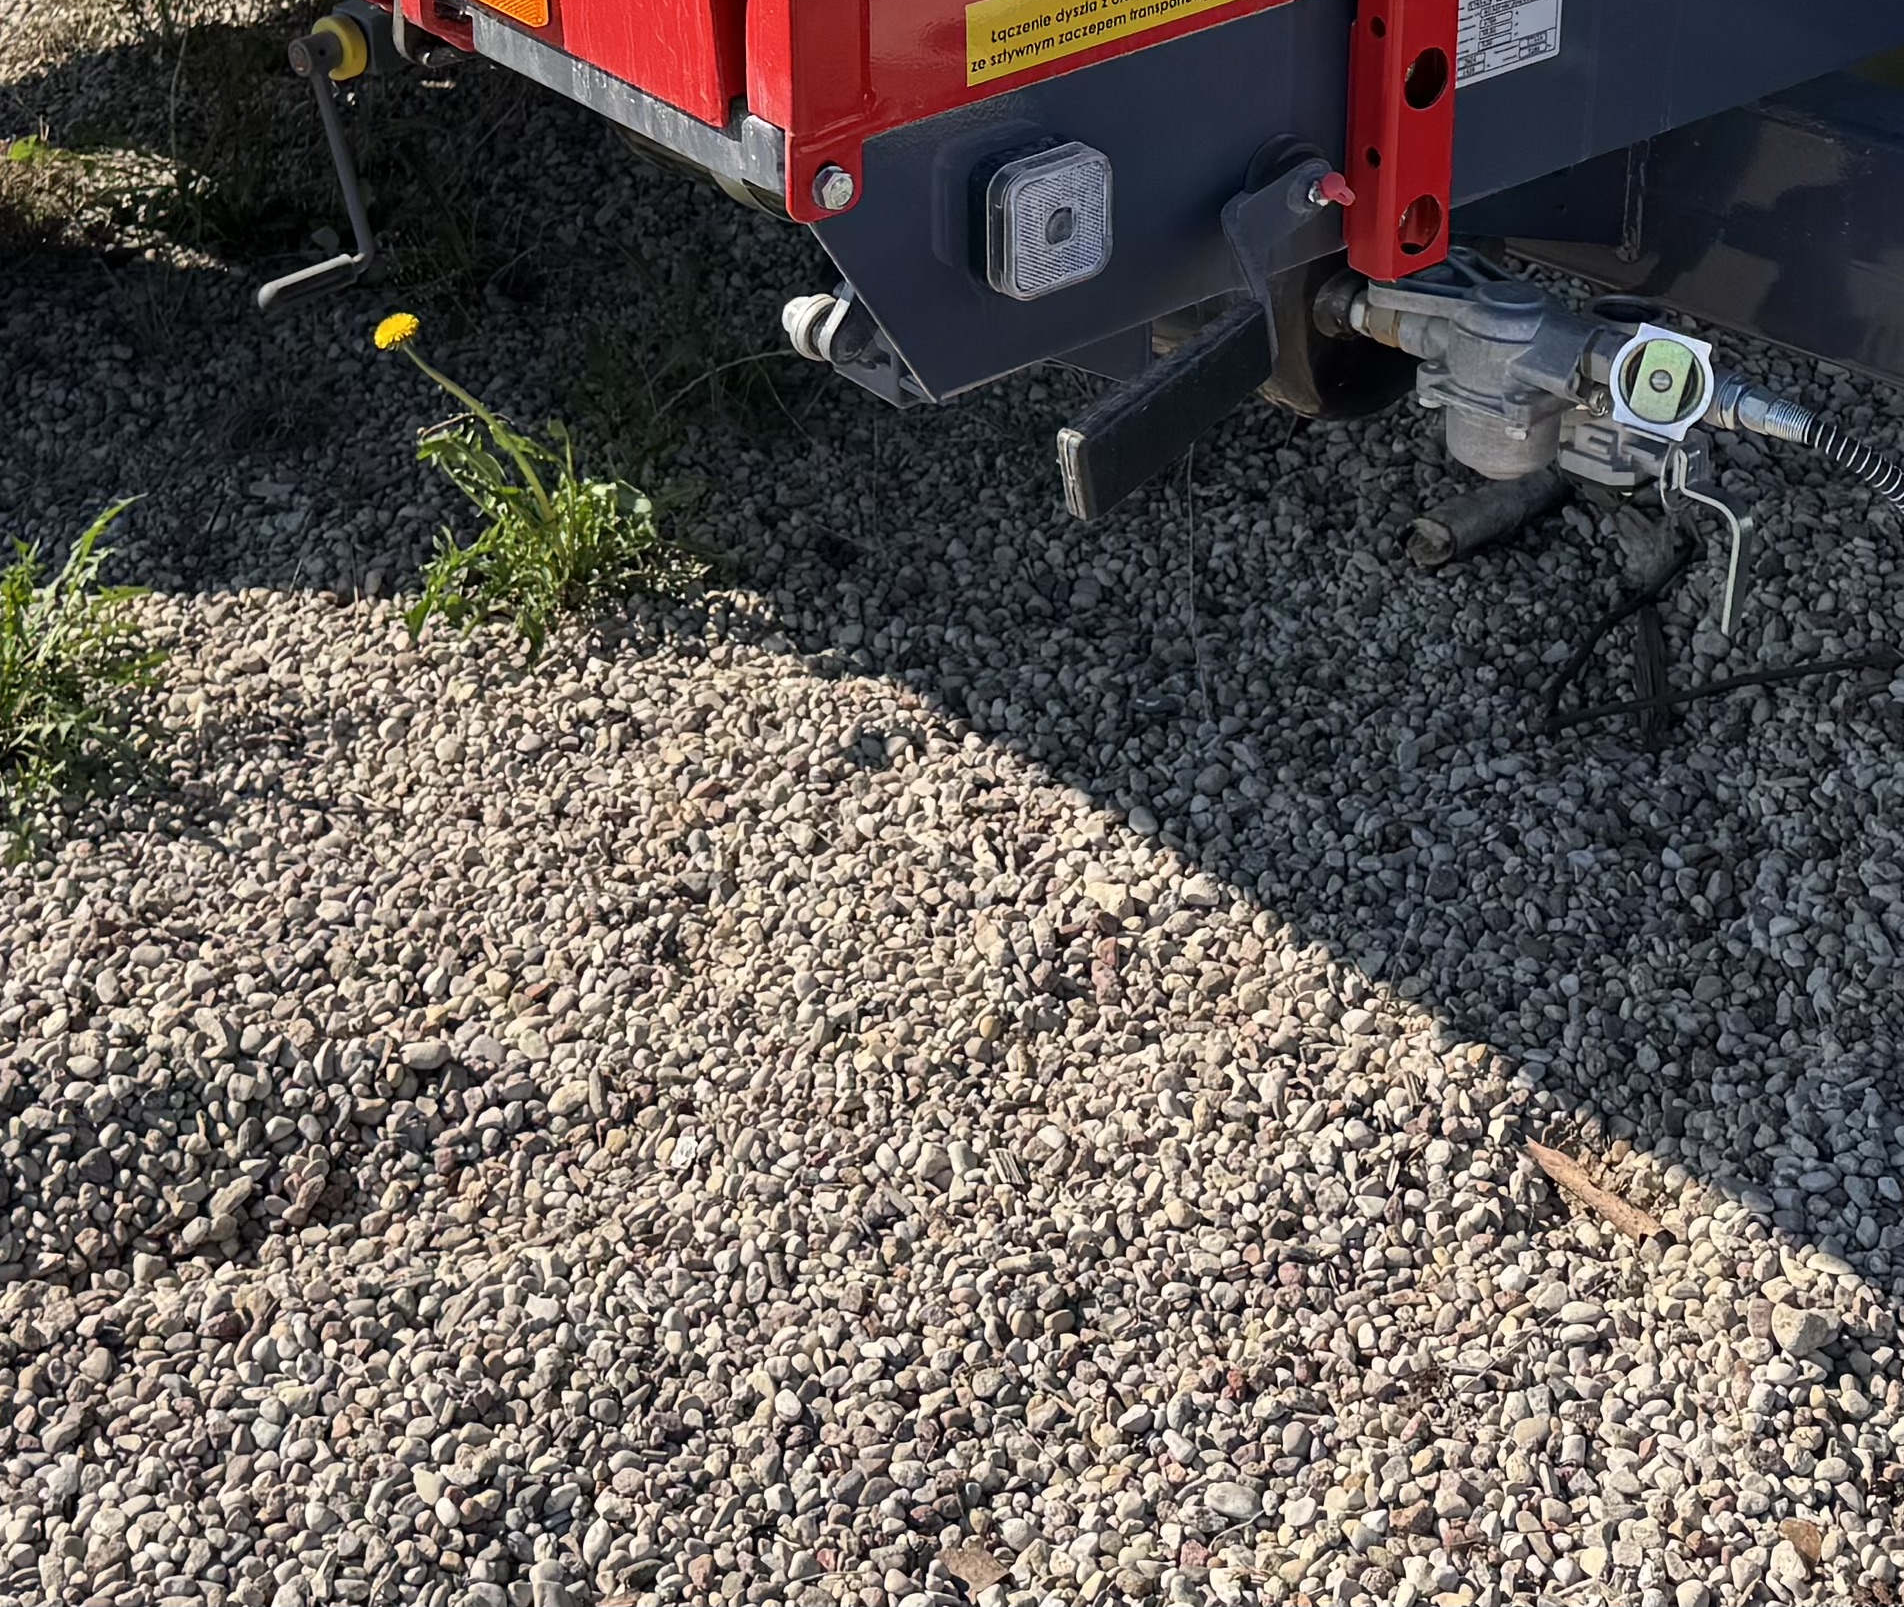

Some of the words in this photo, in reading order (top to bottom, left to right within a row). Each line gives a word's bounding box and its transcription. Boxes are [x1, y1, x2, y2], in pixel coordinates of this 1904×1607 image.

[970, 58, 987, 74] ze
[990, 37, 1055, 68] sztywnym
[1058, 13, 1127, 45] zaczepem
[991, 13, 1052, 44] Łączenie
